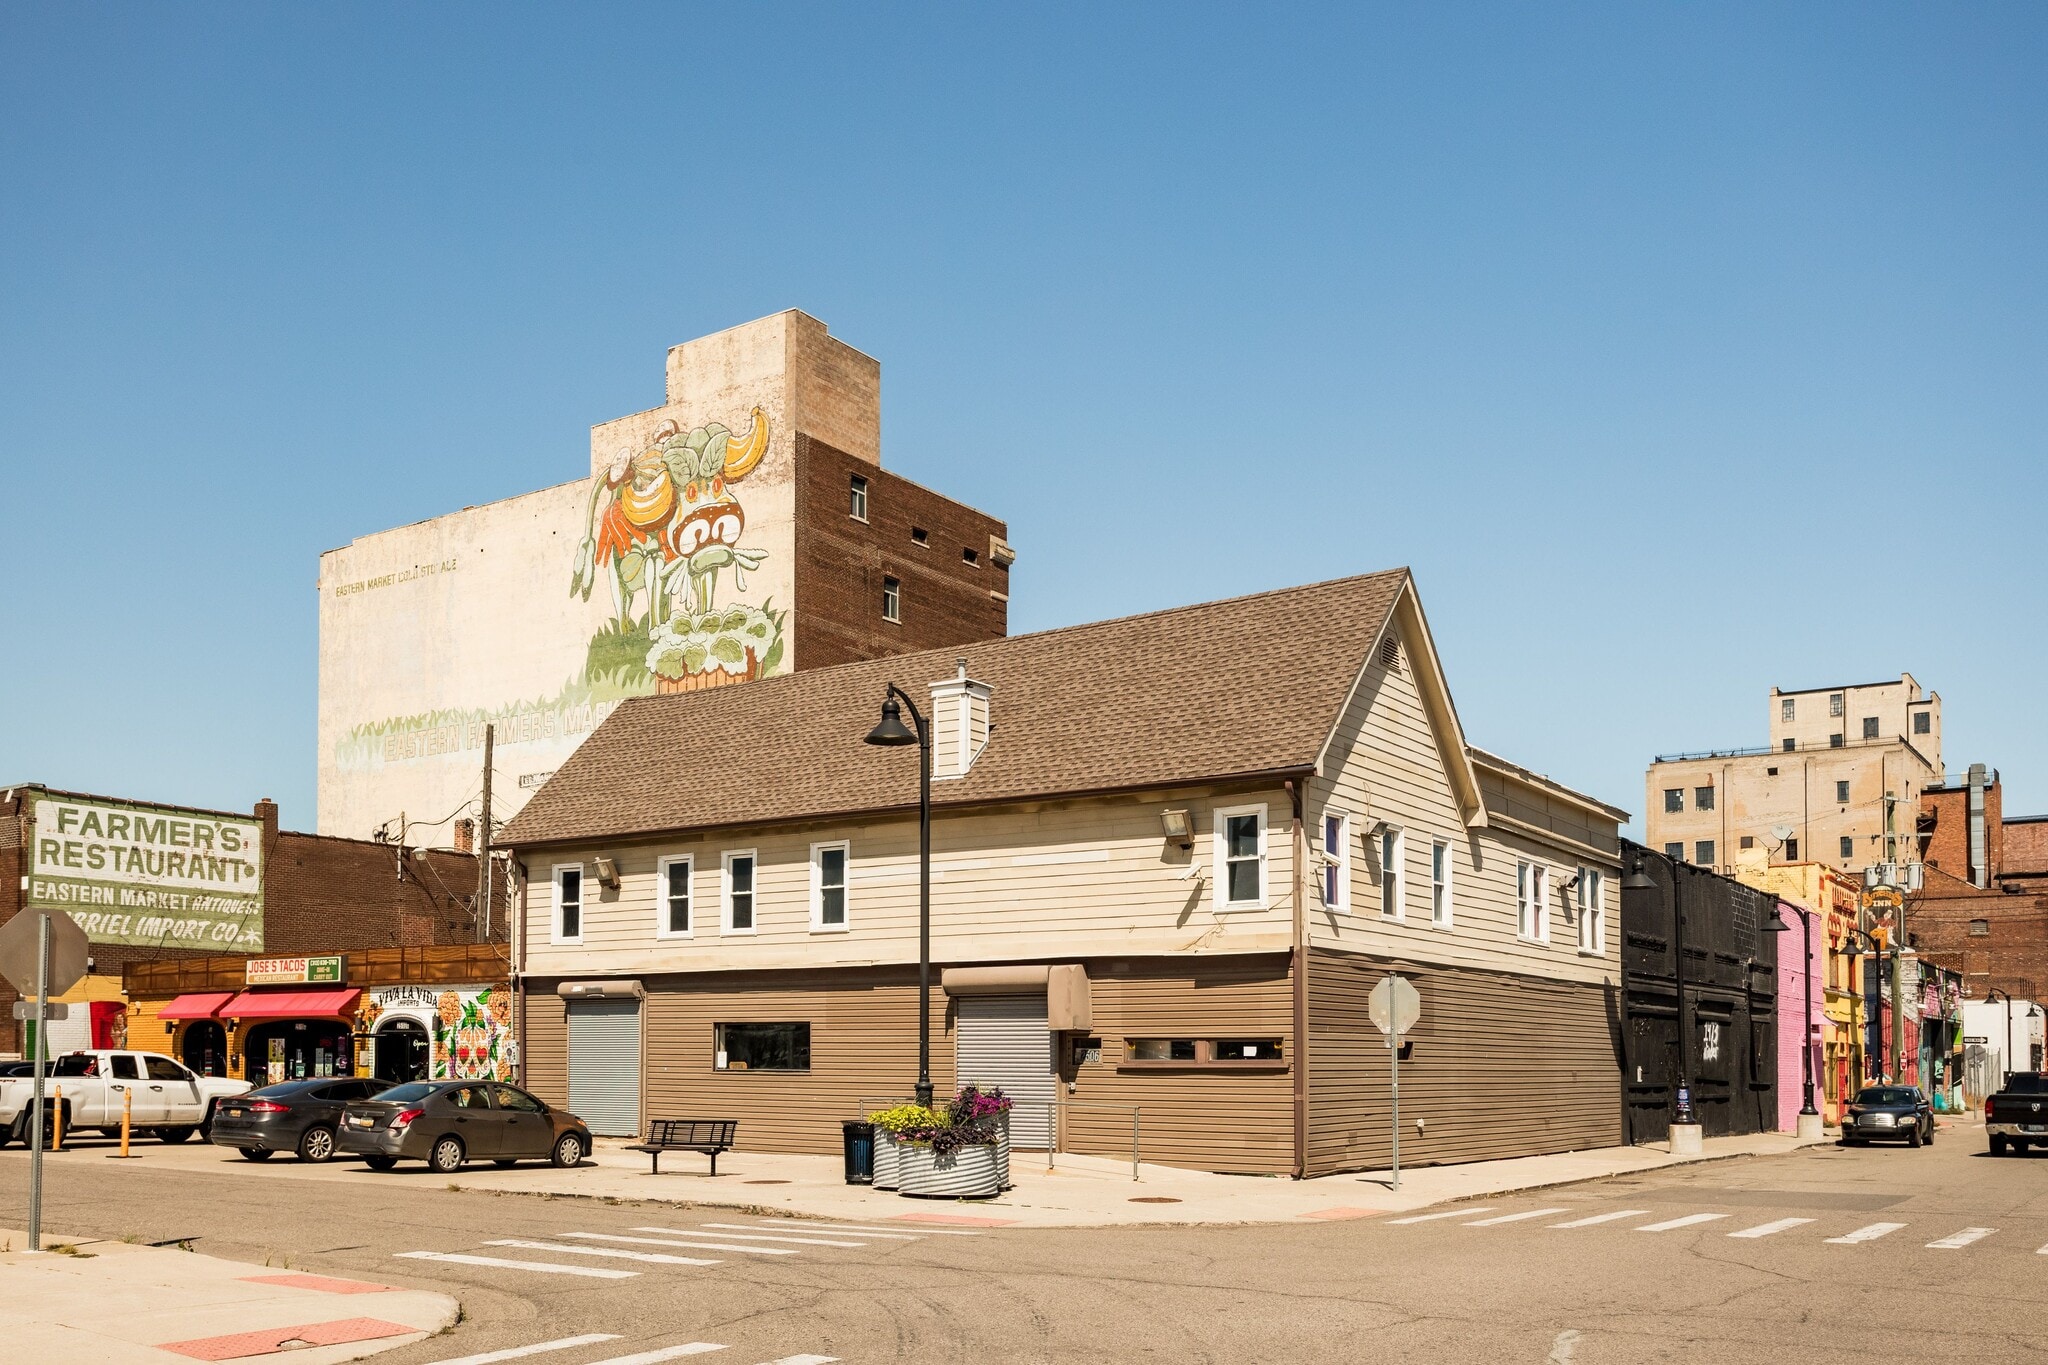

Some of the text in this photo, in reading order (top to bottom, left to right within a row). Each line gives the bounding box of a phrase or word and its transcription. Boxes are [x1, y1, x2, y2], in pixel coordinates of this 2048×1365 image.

[336, 581, 365, 597] EASTERN
[367, 573, 396, 591] MARKET
[384, 723, 460, 763] EASTERN
[58, 807, 241, 852] FARMER'S
[33, 881, 115, 905] EASTERN
[120, 889, 190, 911] MARKET
[135, 917, 211, 940] IMPORT
[211, 922, 244, 943] CO.
[248, 959, 306, 974] JOSE'S TACOS
[379, 986, 439, 1009] VIVA LA VIDA
[412, 1039, 429, 1050] Open
